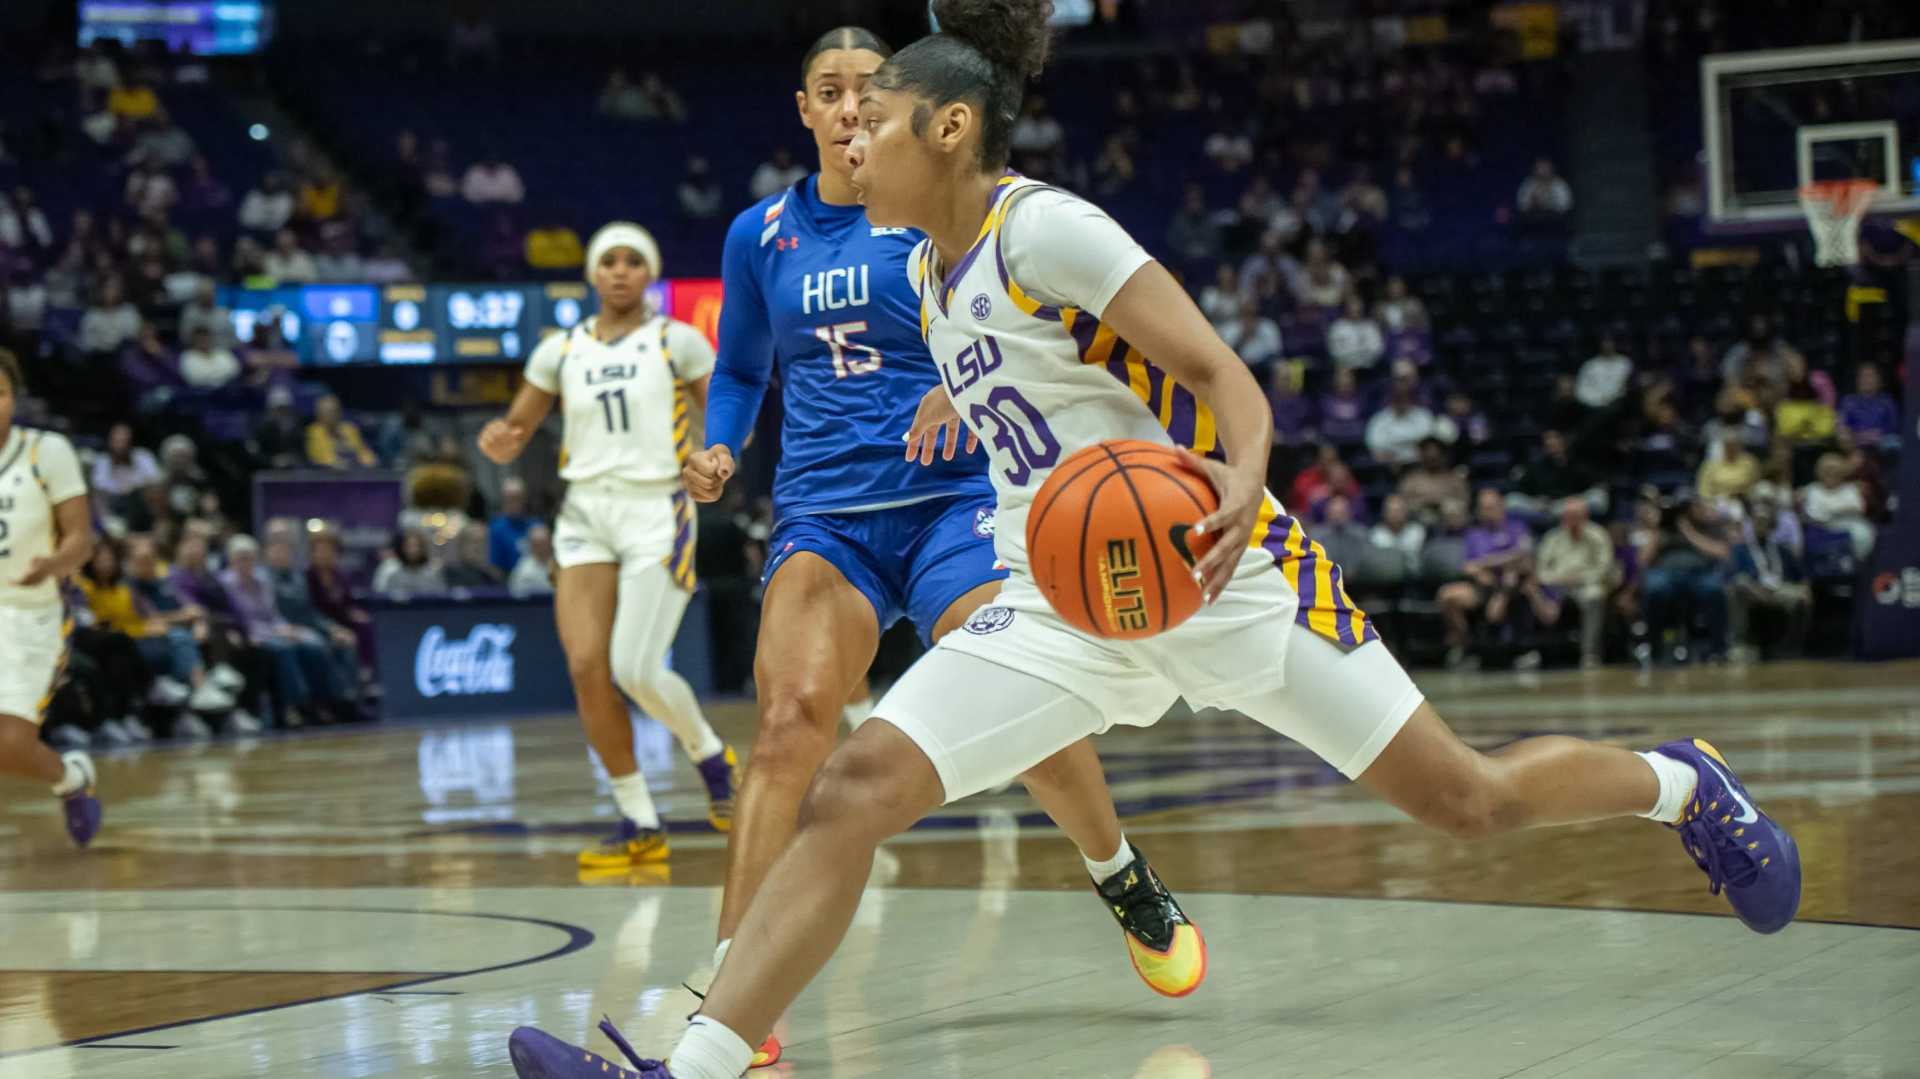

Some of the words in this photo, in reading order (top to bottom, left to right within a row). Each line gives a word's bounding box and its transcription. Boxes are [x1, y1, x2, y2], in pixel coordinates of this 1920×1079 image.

[803, 264, 869, 314] HCU
[586, 364, 637, 385] LSU
[815, 320, 882, 378] 15
[943, 335, 1003, 398] LSU
[596, 388, 630, 432] 11
[970, 386, 1062, 486] 30
[1106, 538, 1149, 632] ELITE
